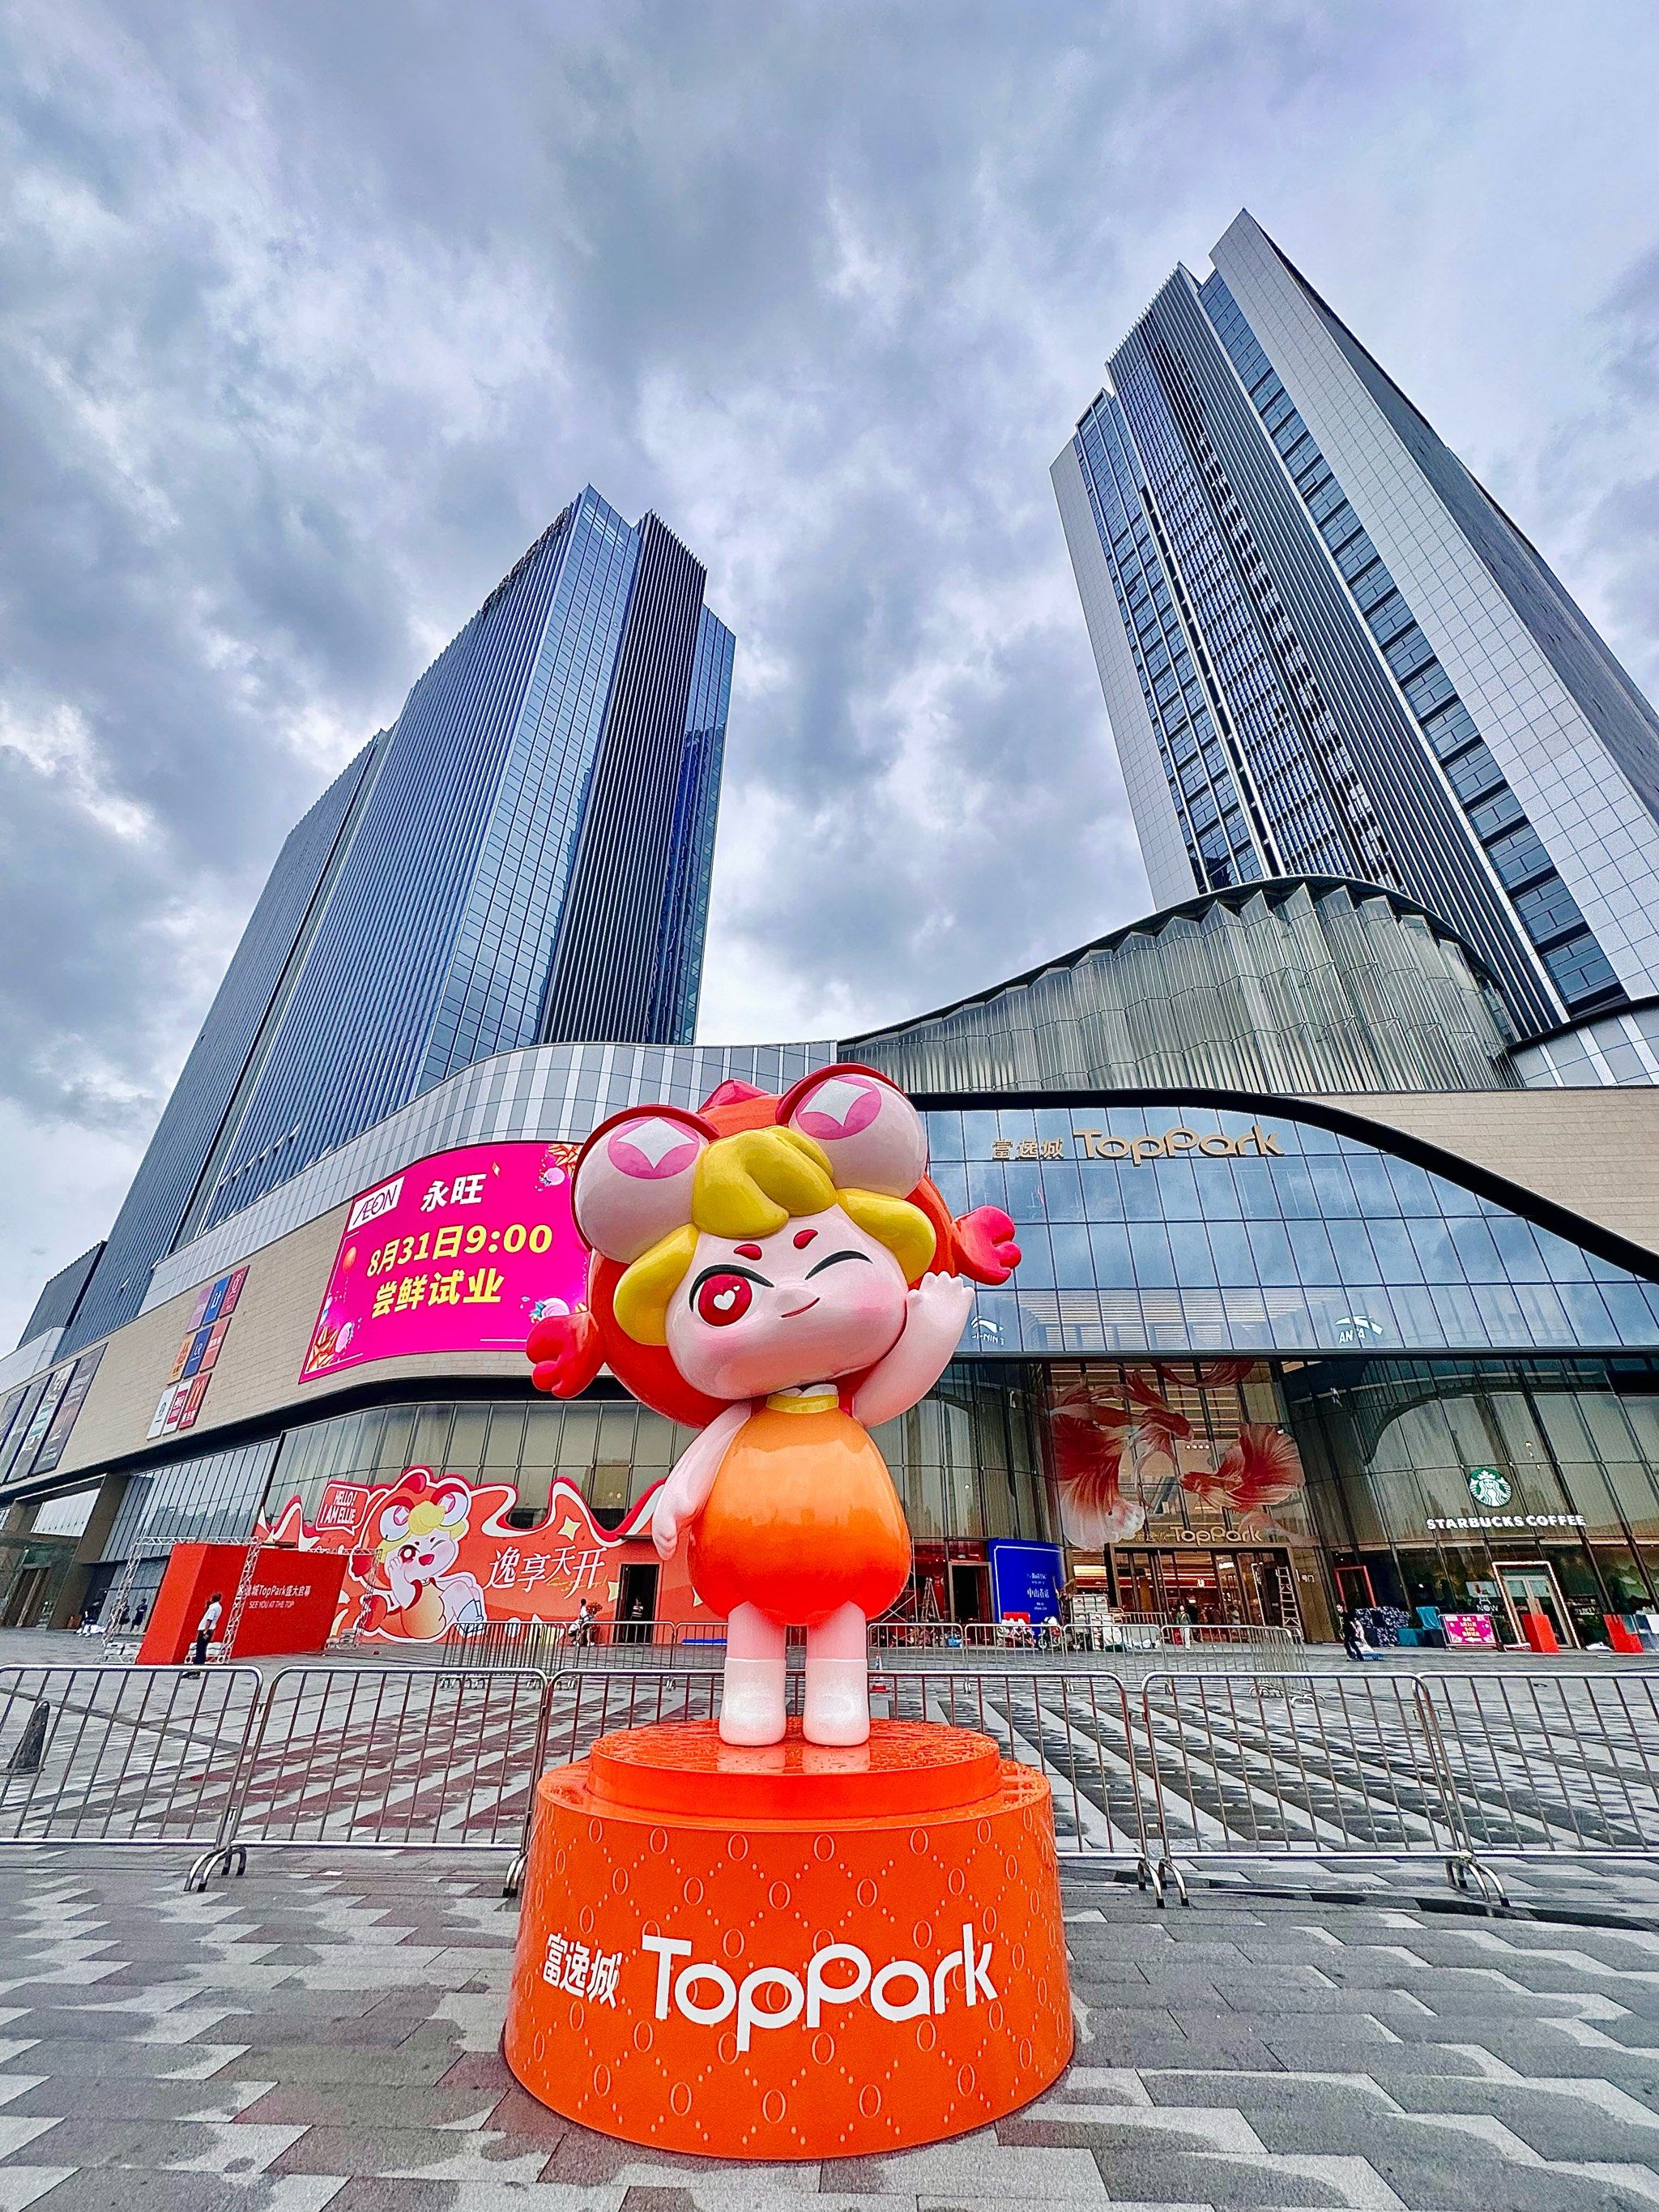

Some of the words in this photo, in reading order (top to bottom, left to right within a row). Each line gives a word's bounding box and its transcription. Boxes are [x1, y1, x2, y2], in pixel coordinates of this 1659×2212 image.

[992, 1138, 1064, 1160] 富逸城
[1073, 1125, 1285, 1167] TopPark
[420, 1174, 487, 1212] 永旺
[366, 1223, 552, 1278] 8月31日9:00
[371, 1268, 505, 1320] 尝鲜试业
[320, 1503, 327, 1524] I
[324, 1505, 339, 1524] AM
[337, 1506, 356, 1524] ELLIE
[333, 1490, 358, 1507] HELLO!
[1170, 1525, 1263, 1546] TopPark
[1426, 1515, 1526, 1530] STARBUCKS
[1525, 1514, 1587, 1527] COFFEE
[483, 1545, 608, 1599] 逸享天开
[542, 1932, 623, 2009] 富逸城
[641, 1922, 1000, 2052] TopPark
